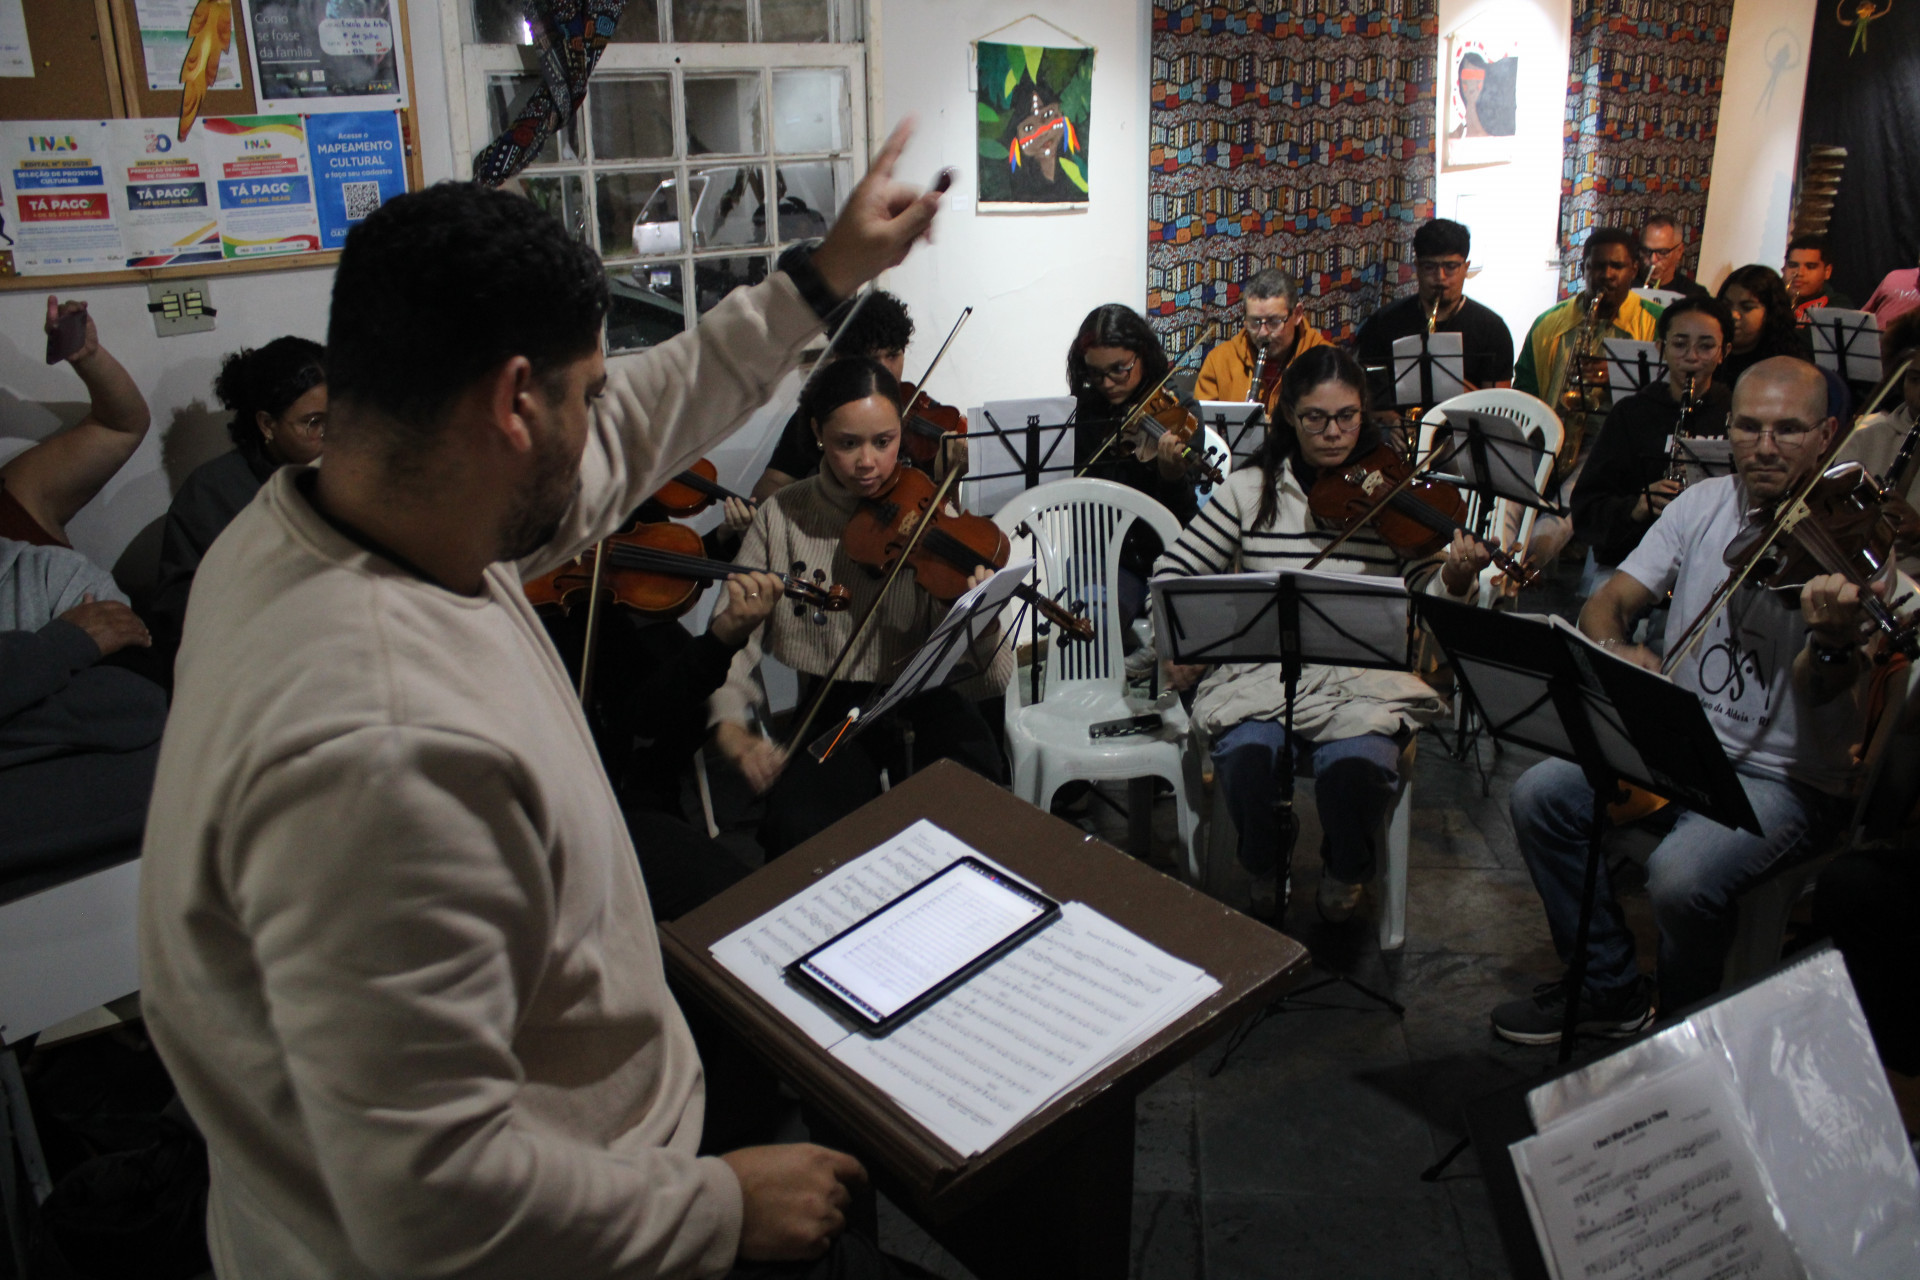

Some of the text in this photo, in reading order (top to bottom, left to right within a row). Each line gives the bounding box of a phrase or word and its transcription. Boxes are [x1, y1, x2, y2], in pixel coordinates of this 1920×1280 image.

[255, 14, 288, 25] Como
[257, 30, 300, 41] se fosse
[259, 46, 313, 58] da família
[317, 140, 393, 154] MAPEAMENTO
[329, 155, 385, 168] CULTURAL
[18, 170, 50, 179] SELEÇÃO
[331, 171, 347, 179] faça
[361, 168, 393, 176] cadastro
[137, 188, 189, 199] TÁ PAGO
[229, 183, 290, 196] TÁ PAGO
[29, 198, 89, 210] TÁ PAGO
[1713, 703, 1723, 714] da
[1725, 707, 1749, 723] Aldeia
